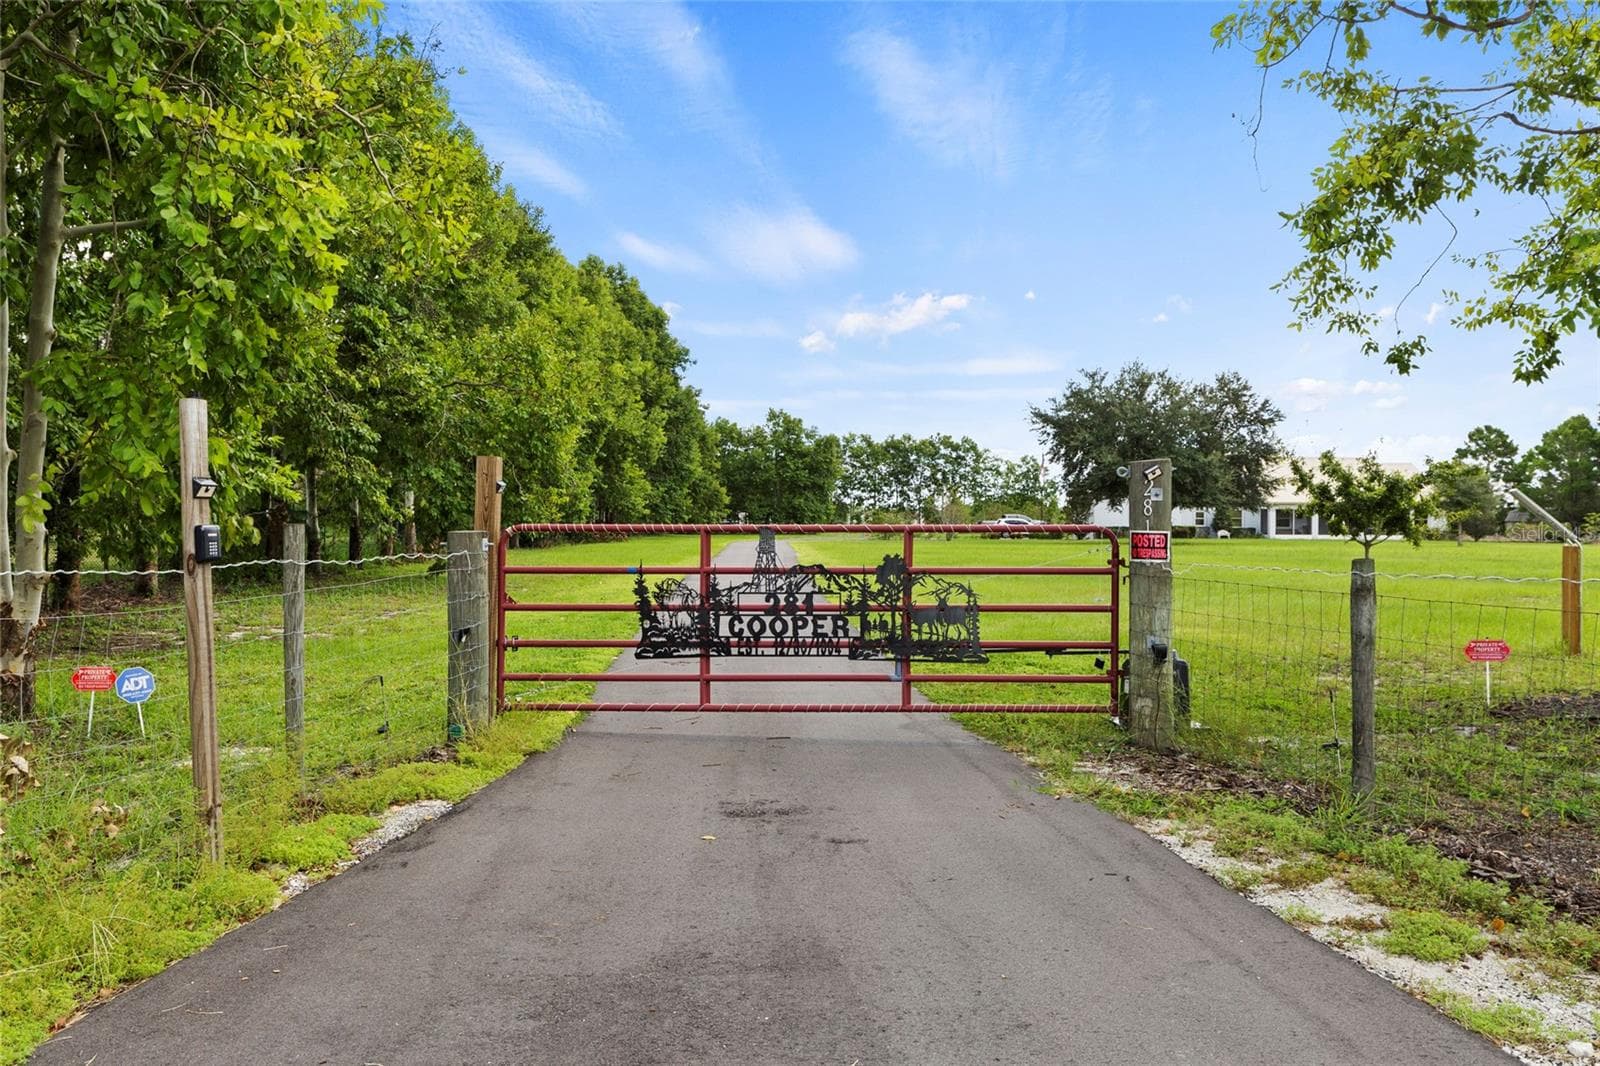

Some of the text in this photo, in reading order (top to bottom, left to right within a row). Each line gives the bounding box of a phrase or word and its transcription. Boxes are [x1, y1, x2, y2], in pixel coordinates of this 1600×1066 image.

[1133, 534, 1166, 548] POSTED
[763, 593, 814, 615] 281
[728, 615, 849, 637] COOPER
[121, 675, 150, 693] ADT
